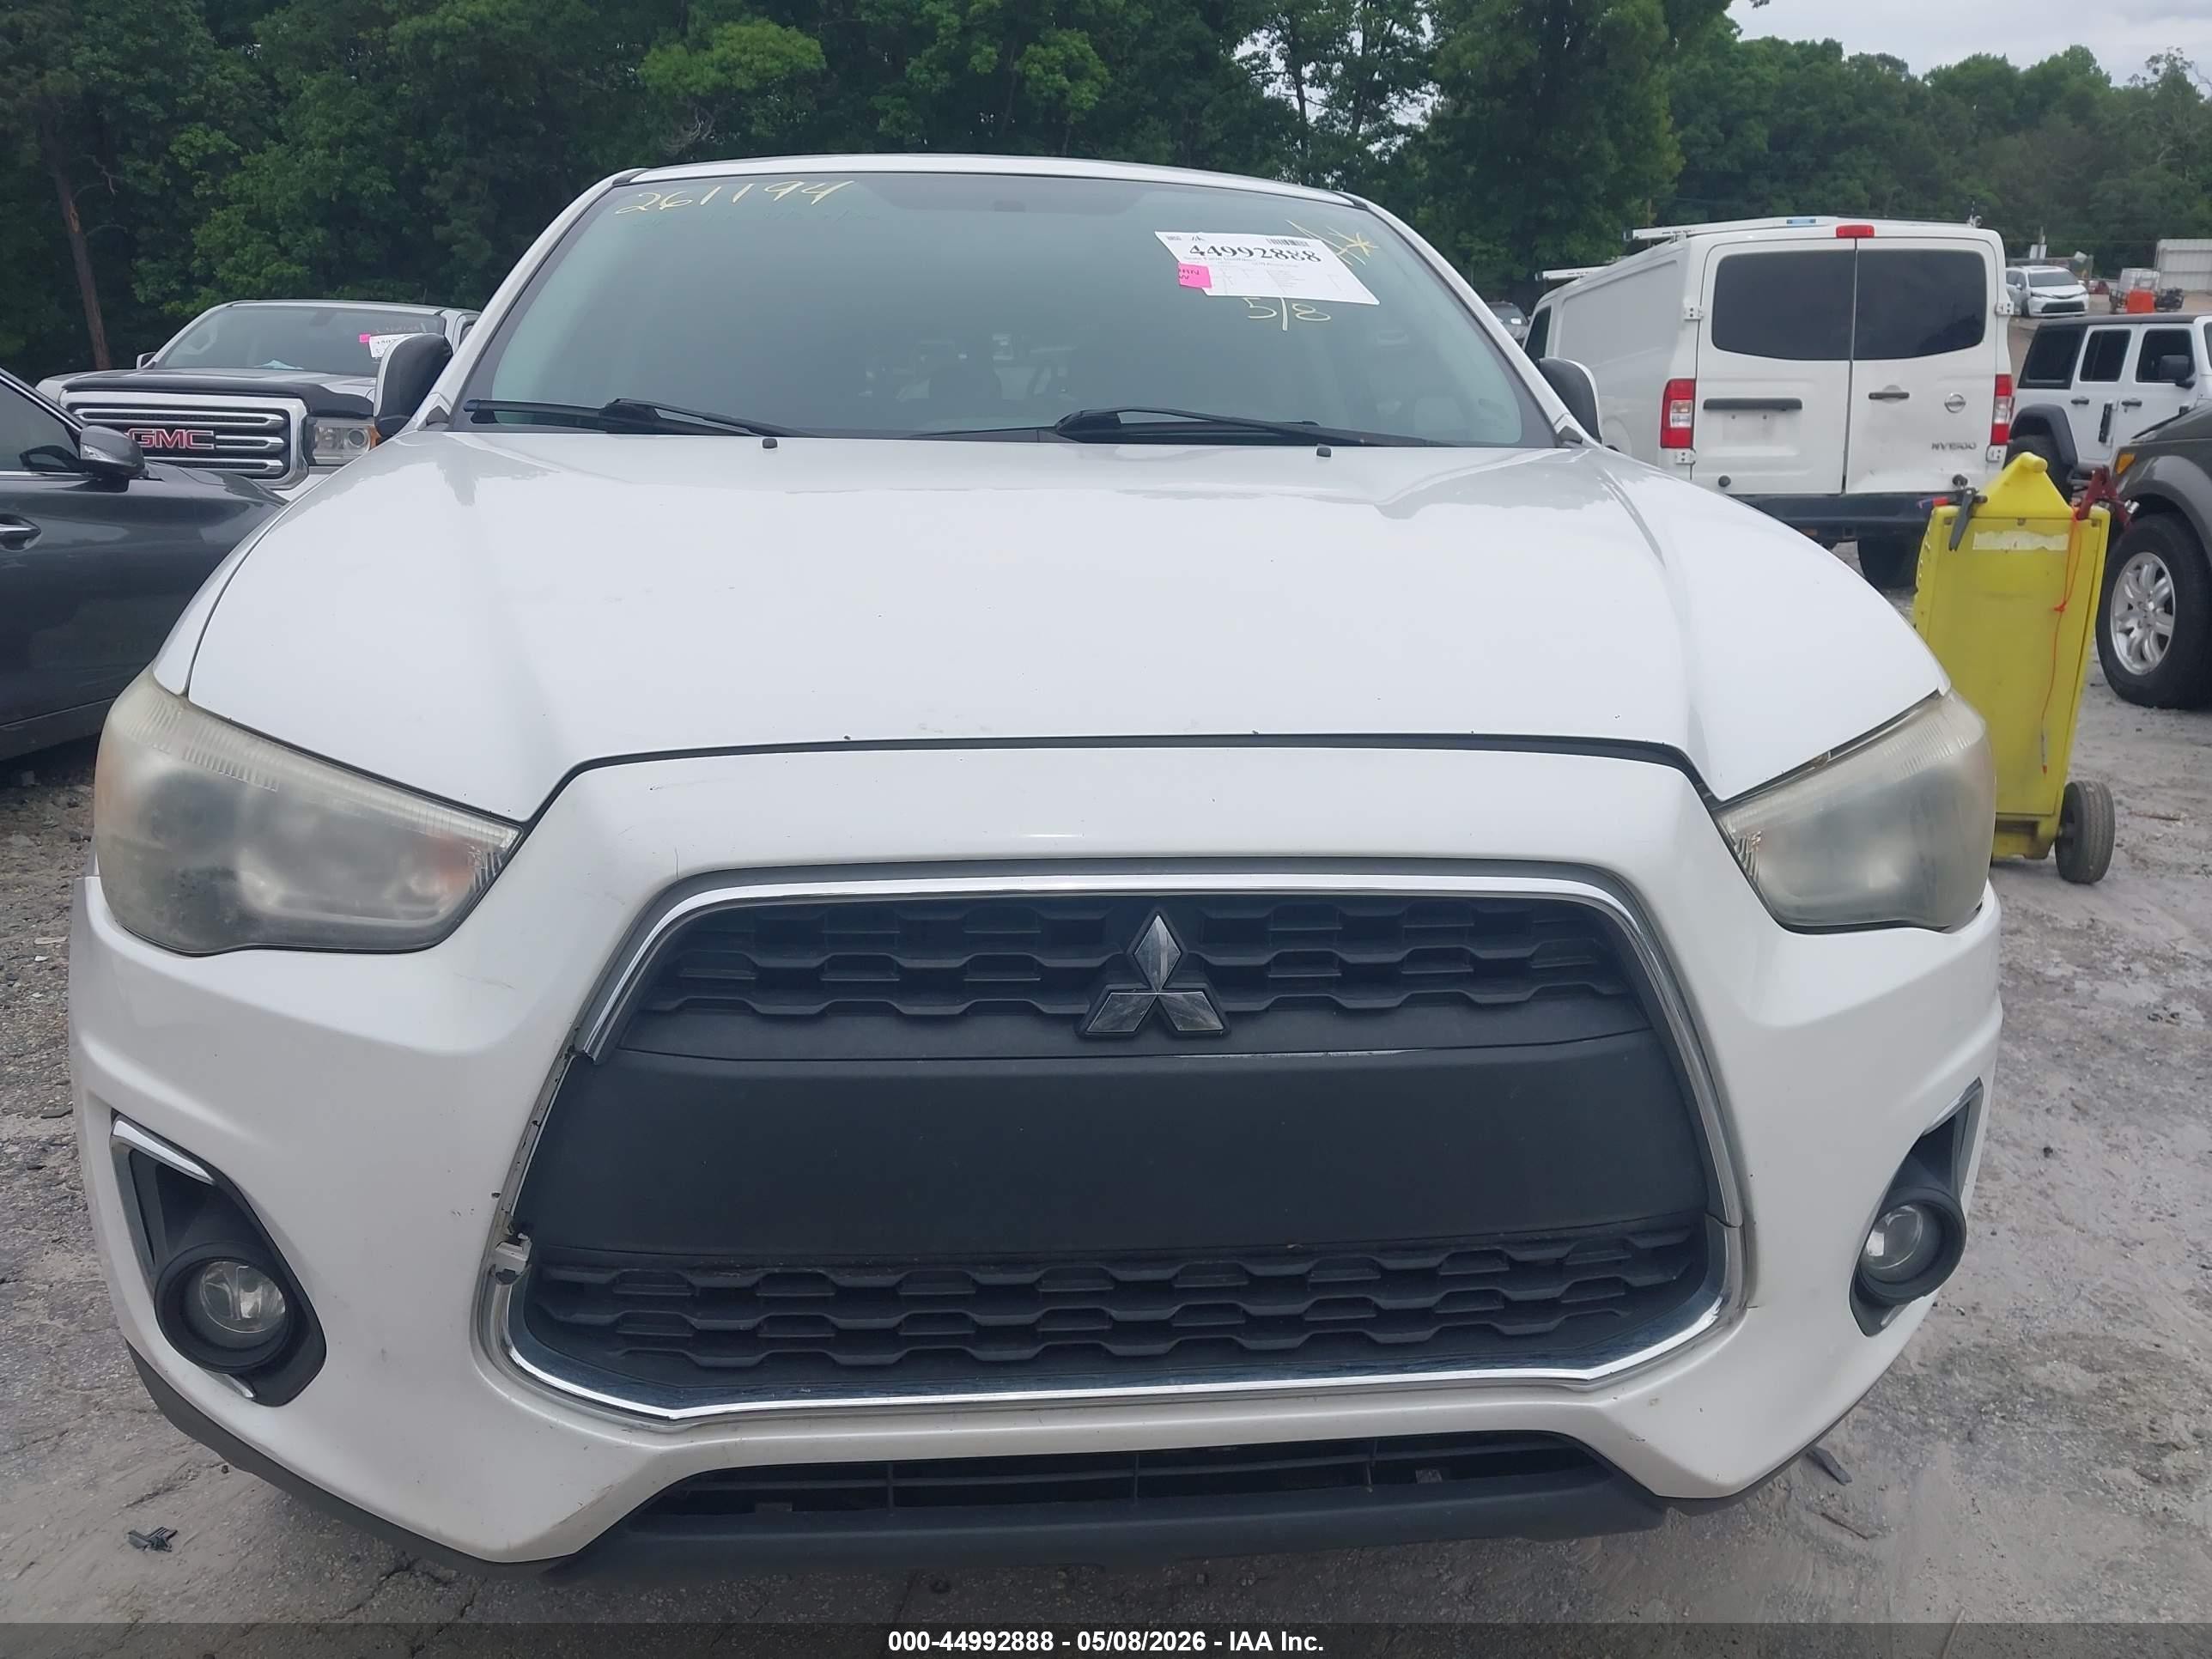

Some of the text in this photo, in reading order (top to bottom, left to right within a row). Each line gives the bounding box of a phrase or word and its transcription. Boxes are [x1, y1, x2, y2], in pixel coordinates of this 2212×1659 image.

[614, 180, 855, 215] 261194
[1188, 245, 1322, 262] 44992888
[128, 428, 215, 449] GMC
